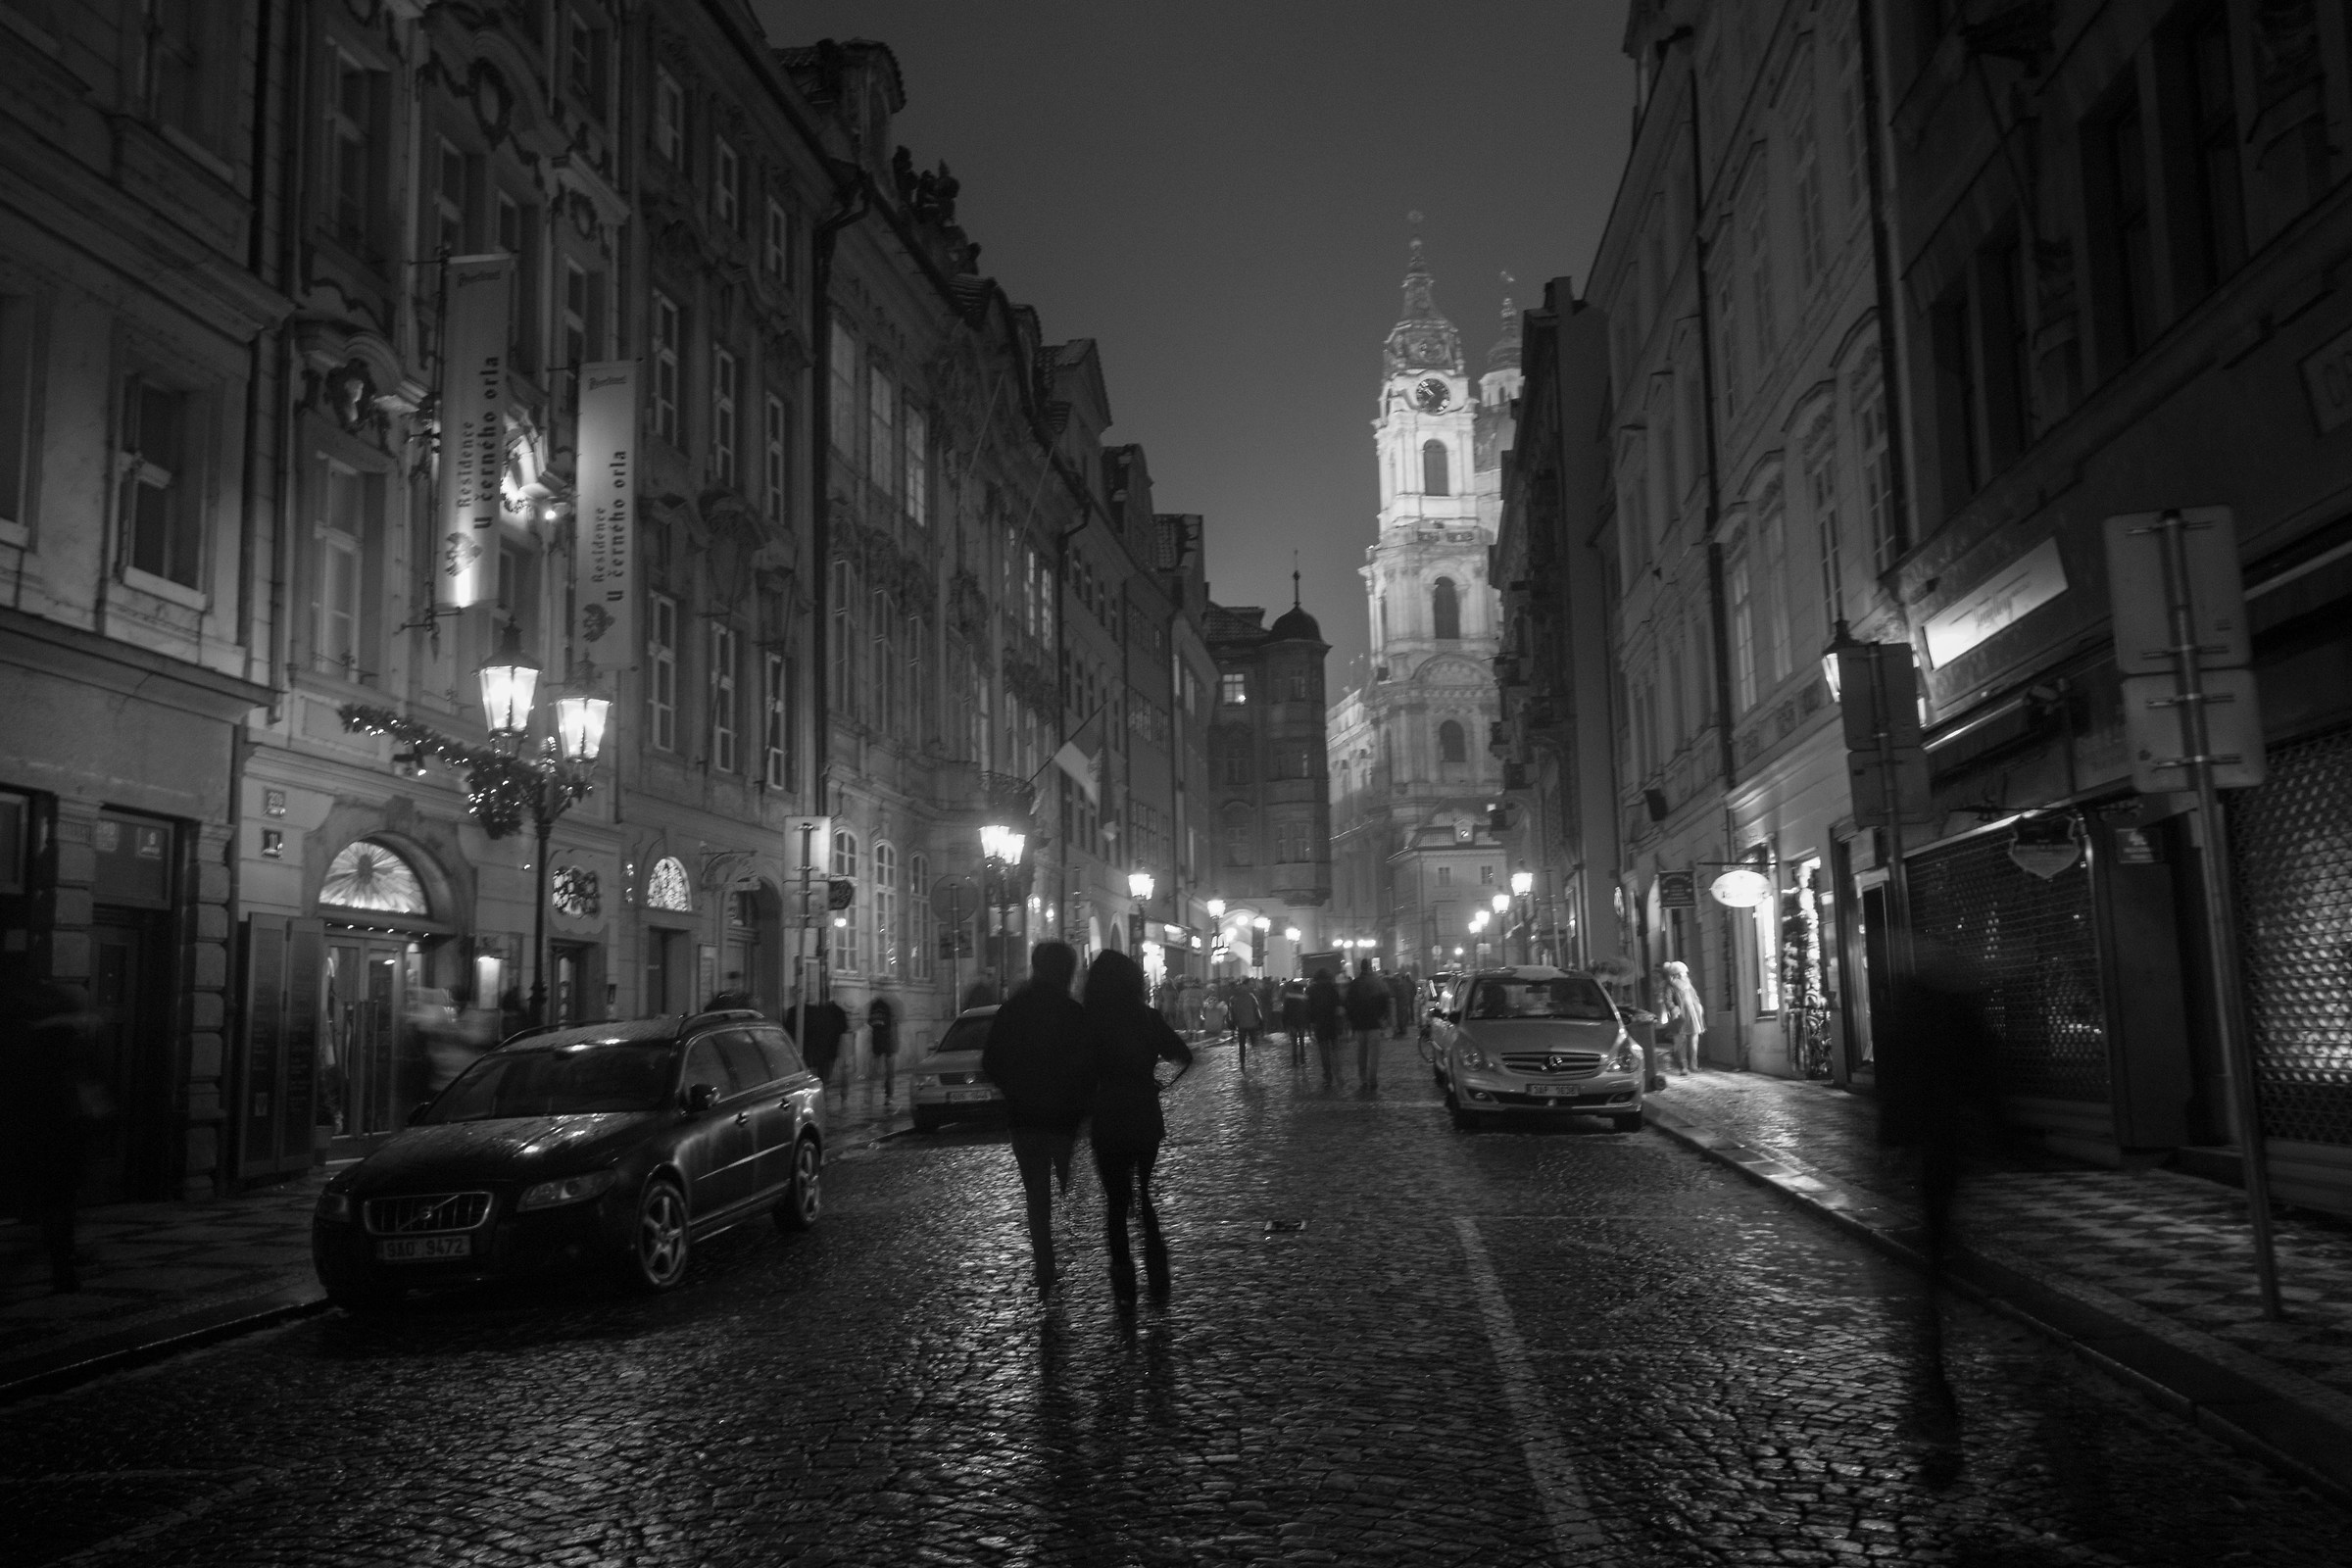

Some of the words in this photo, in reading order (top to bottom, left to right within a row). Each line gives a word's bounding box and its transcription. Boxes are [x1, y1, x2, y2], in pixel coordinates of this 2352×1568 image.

[479, 357, 499, 400] orla
[457, 421, 473, 508] Residence
[473, 412, 497, 502] černého
[610, 451, 626, 488] orla
[591, 507, 607, 582] Residence
[607, 499, 626, 578] černého
[425, 1238, 465, 1255] 9472
